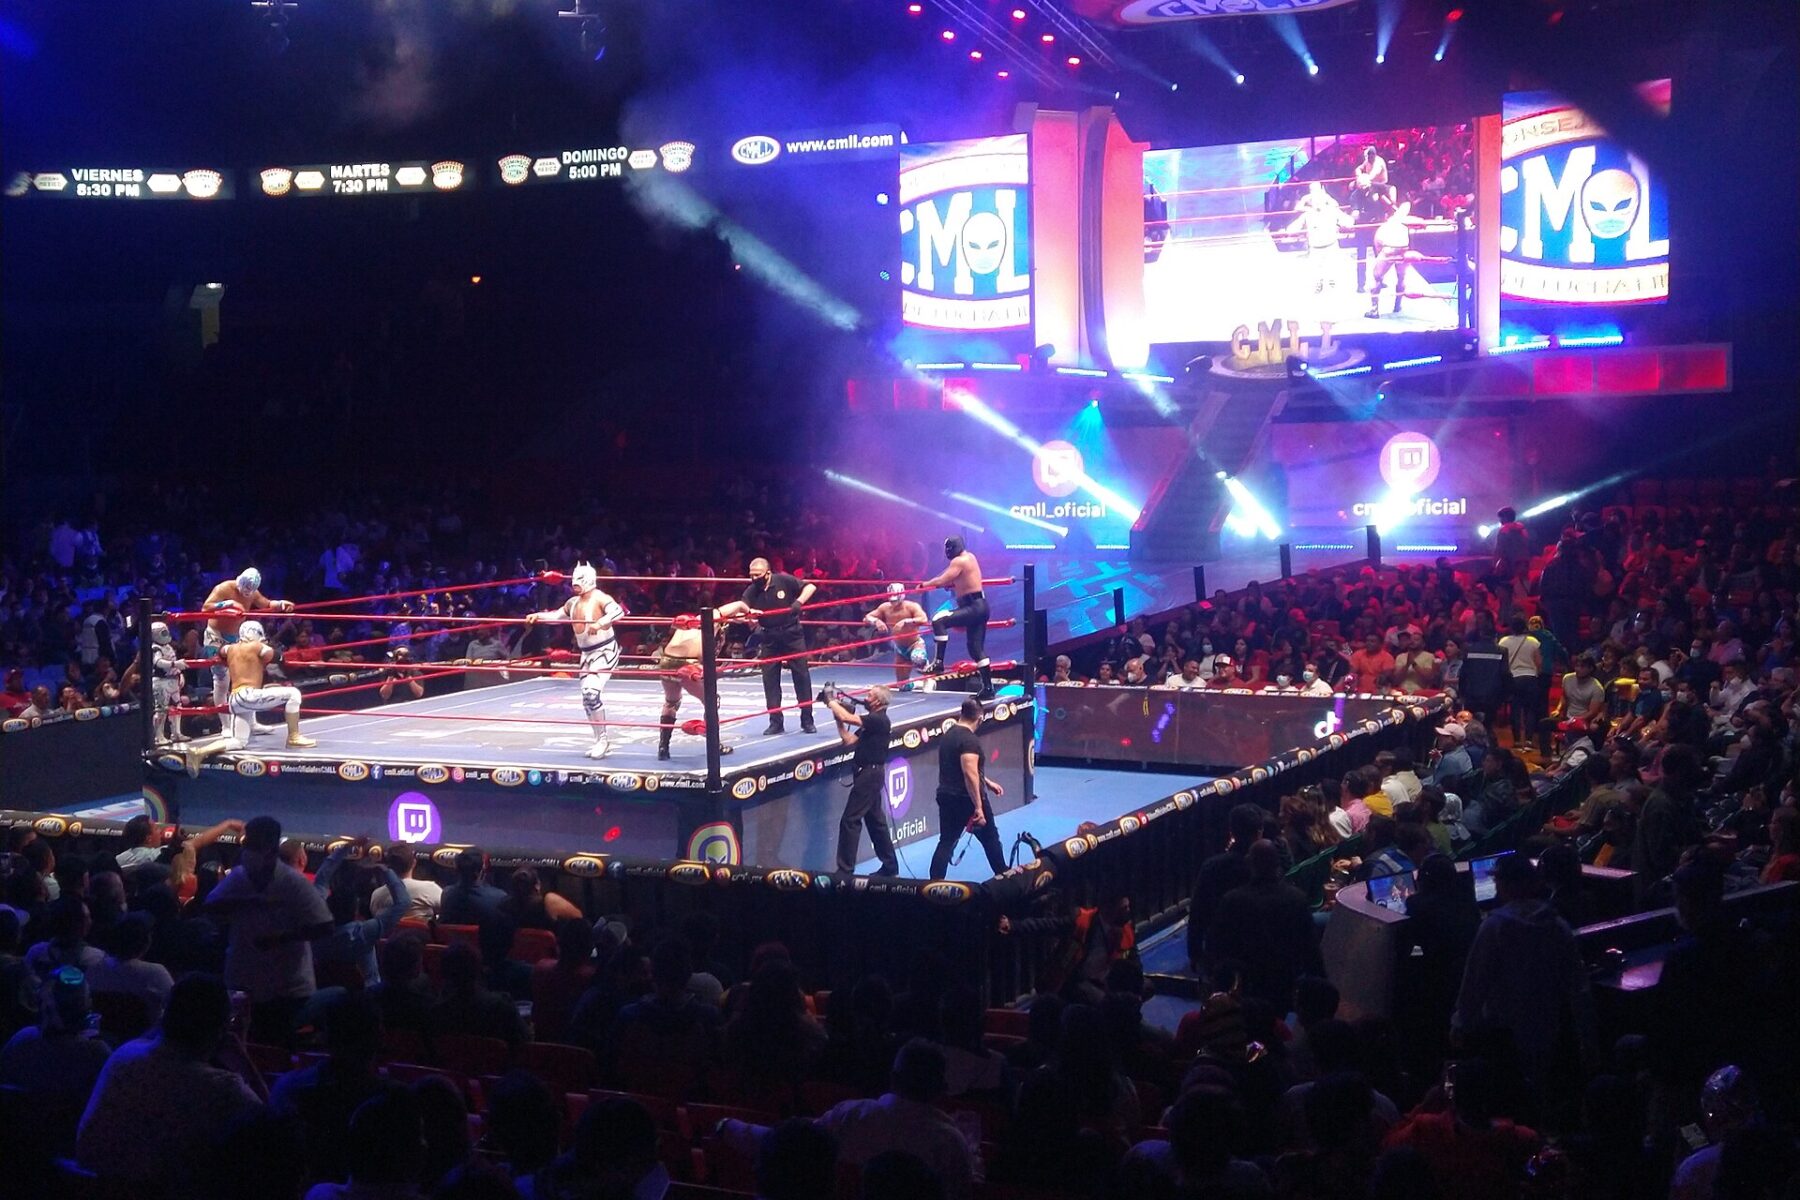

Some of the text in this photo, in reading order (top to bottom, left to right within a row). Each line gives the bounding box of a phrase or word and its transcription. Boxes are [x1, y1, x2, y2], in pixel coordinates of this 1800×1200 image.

[786, 134, 894, 153] www.cmll.com
[562, 147, 628, 164] DOMINGO
[71, 168, 144, 182] VIERNES
[330, 163, 391, 179] MARTES
[568, 163, 621, 179] 5:00 PM
[114, 184, 140, 197] PM
[332, 178, 388, 193] 7:30 PM
[1231, 318, 1342, 363] CMLL
[1010, 502, 1106, 519] cmll_oficial
